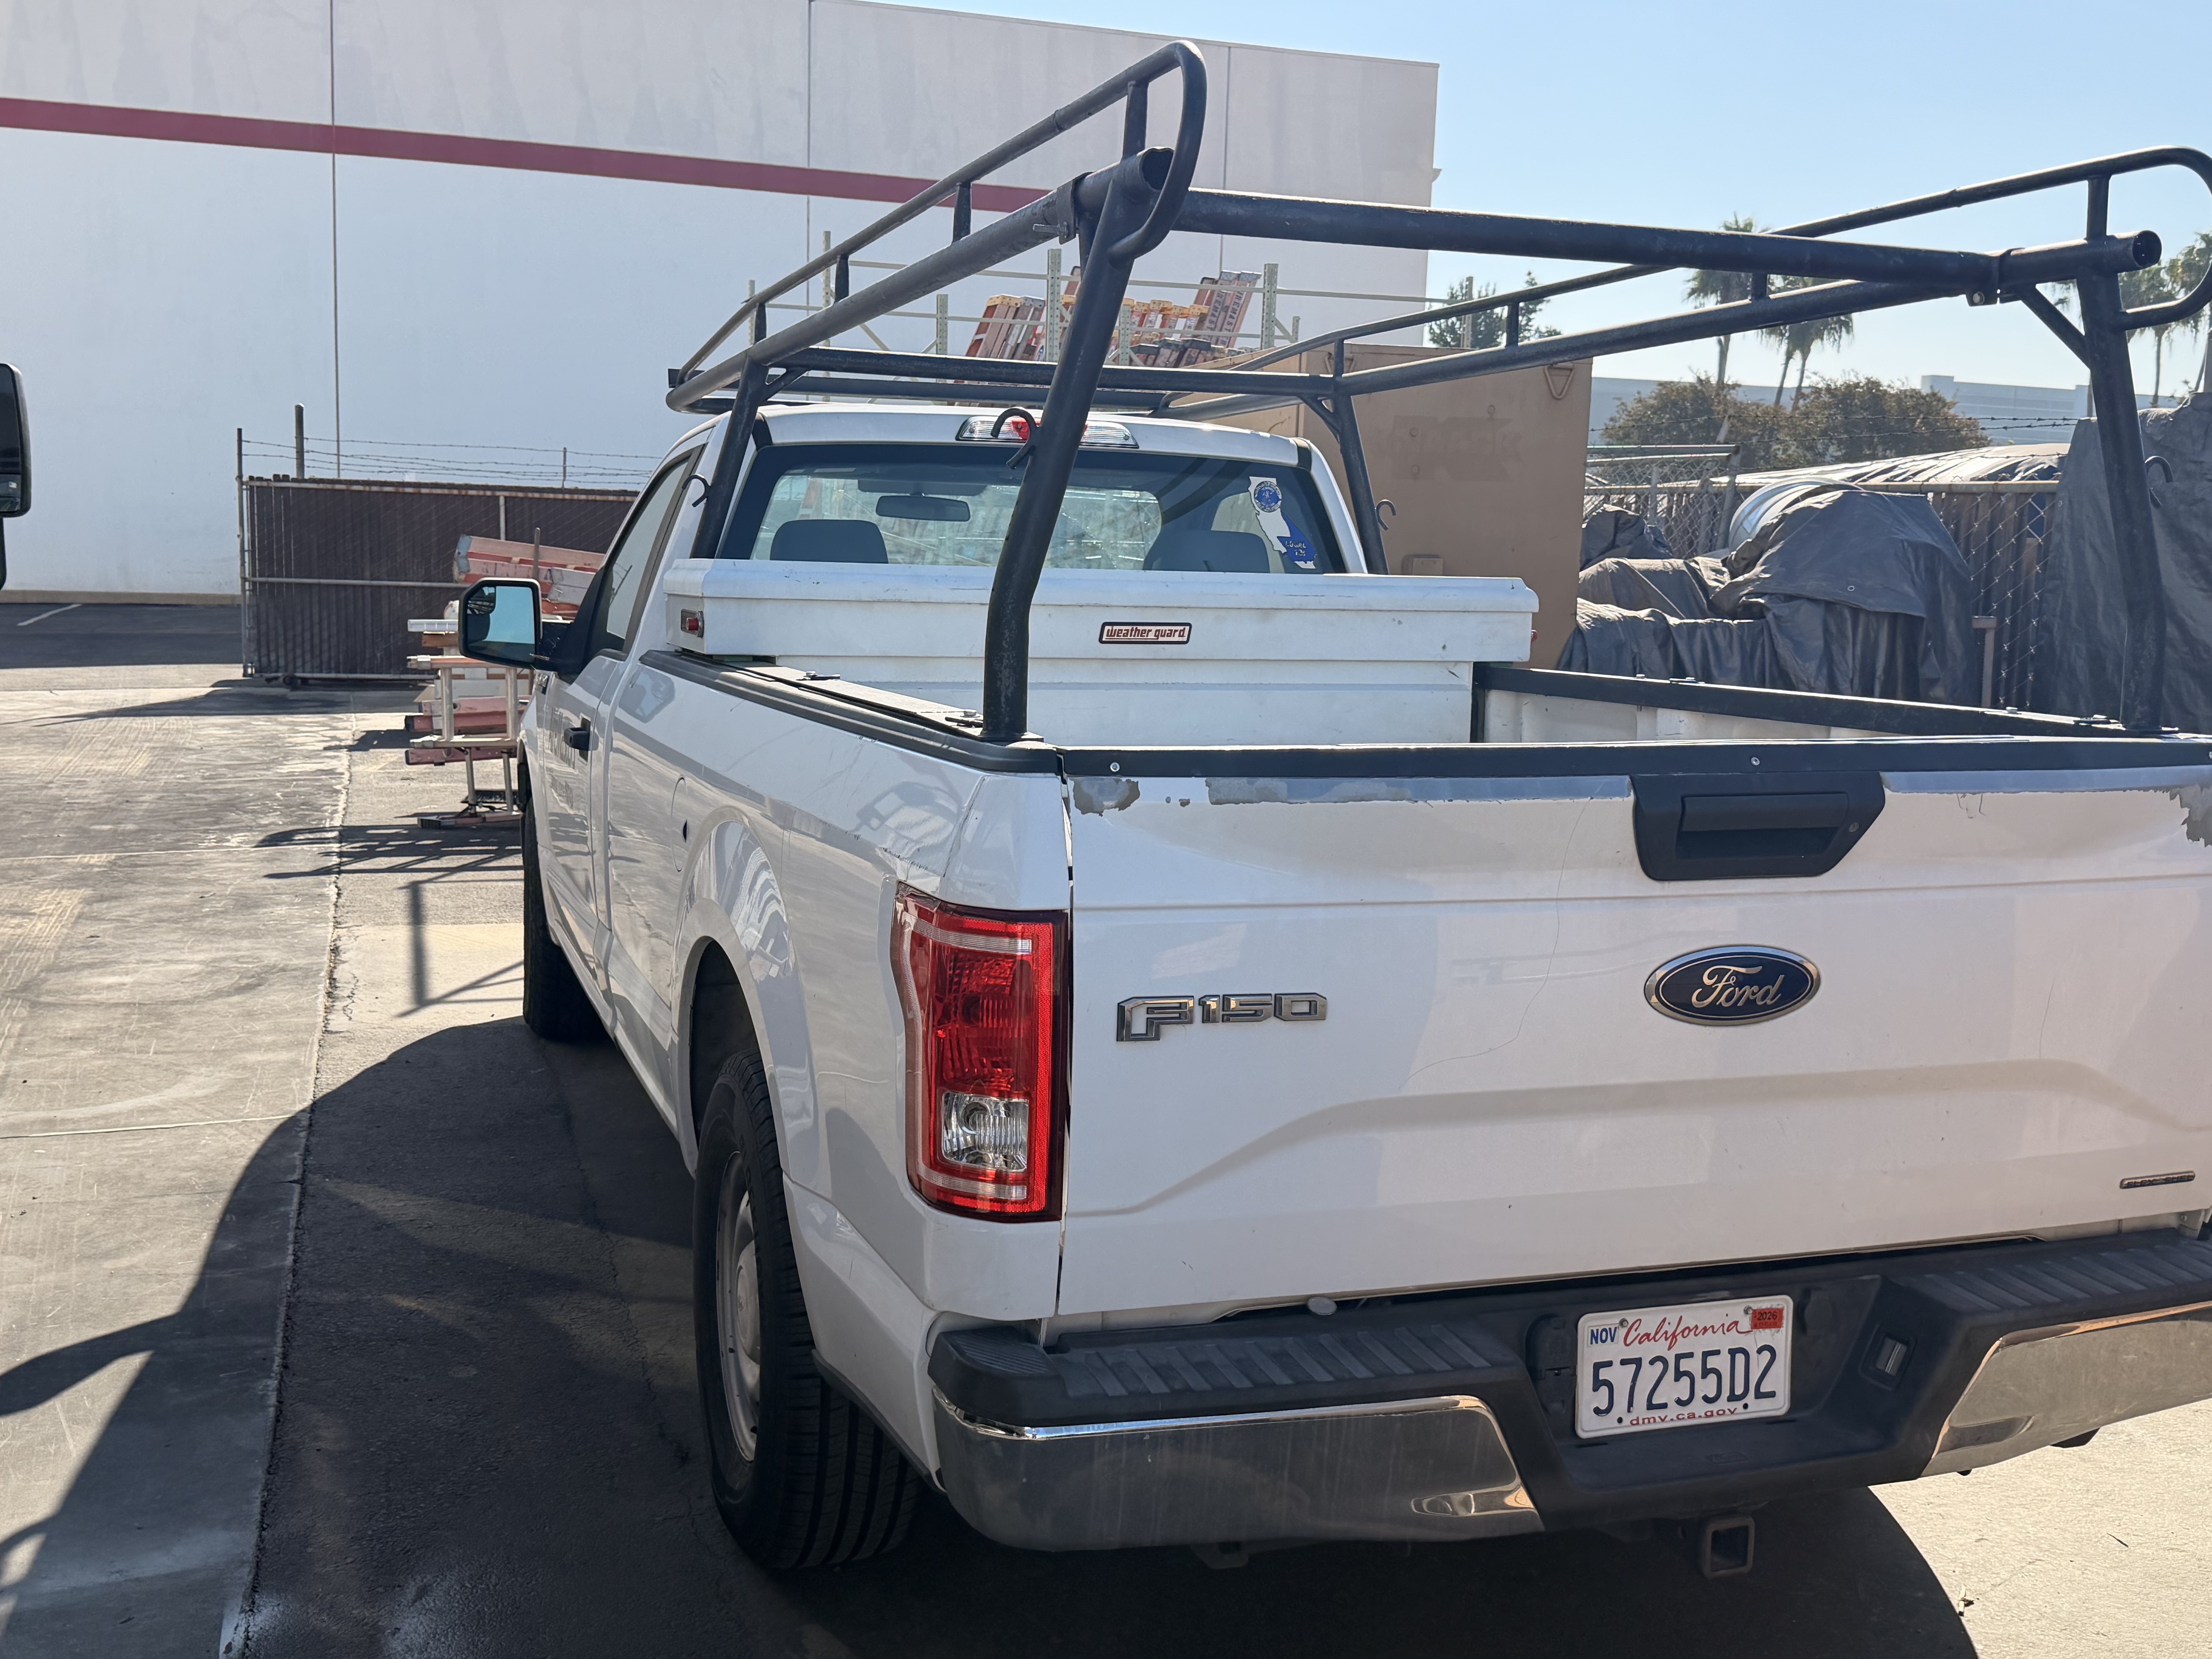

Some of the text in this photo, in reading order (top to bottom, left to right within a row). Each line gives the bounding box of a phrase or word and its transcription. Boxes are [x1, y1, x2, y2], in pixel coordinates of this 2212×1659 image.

[1106, 626, 1186, 640] weather guard
[1692, 965, 1784, 1008] Ford
[1757, 1311, 1778, 1321] 2026
[1590, 1327, 1617, 1345] NOV
[1623, 1314, 1752, 1351] California
[1592, 1344, 1777, 1416] 57255D2
[1630, 1407, 1737, 1426] dmv.ca.gov
